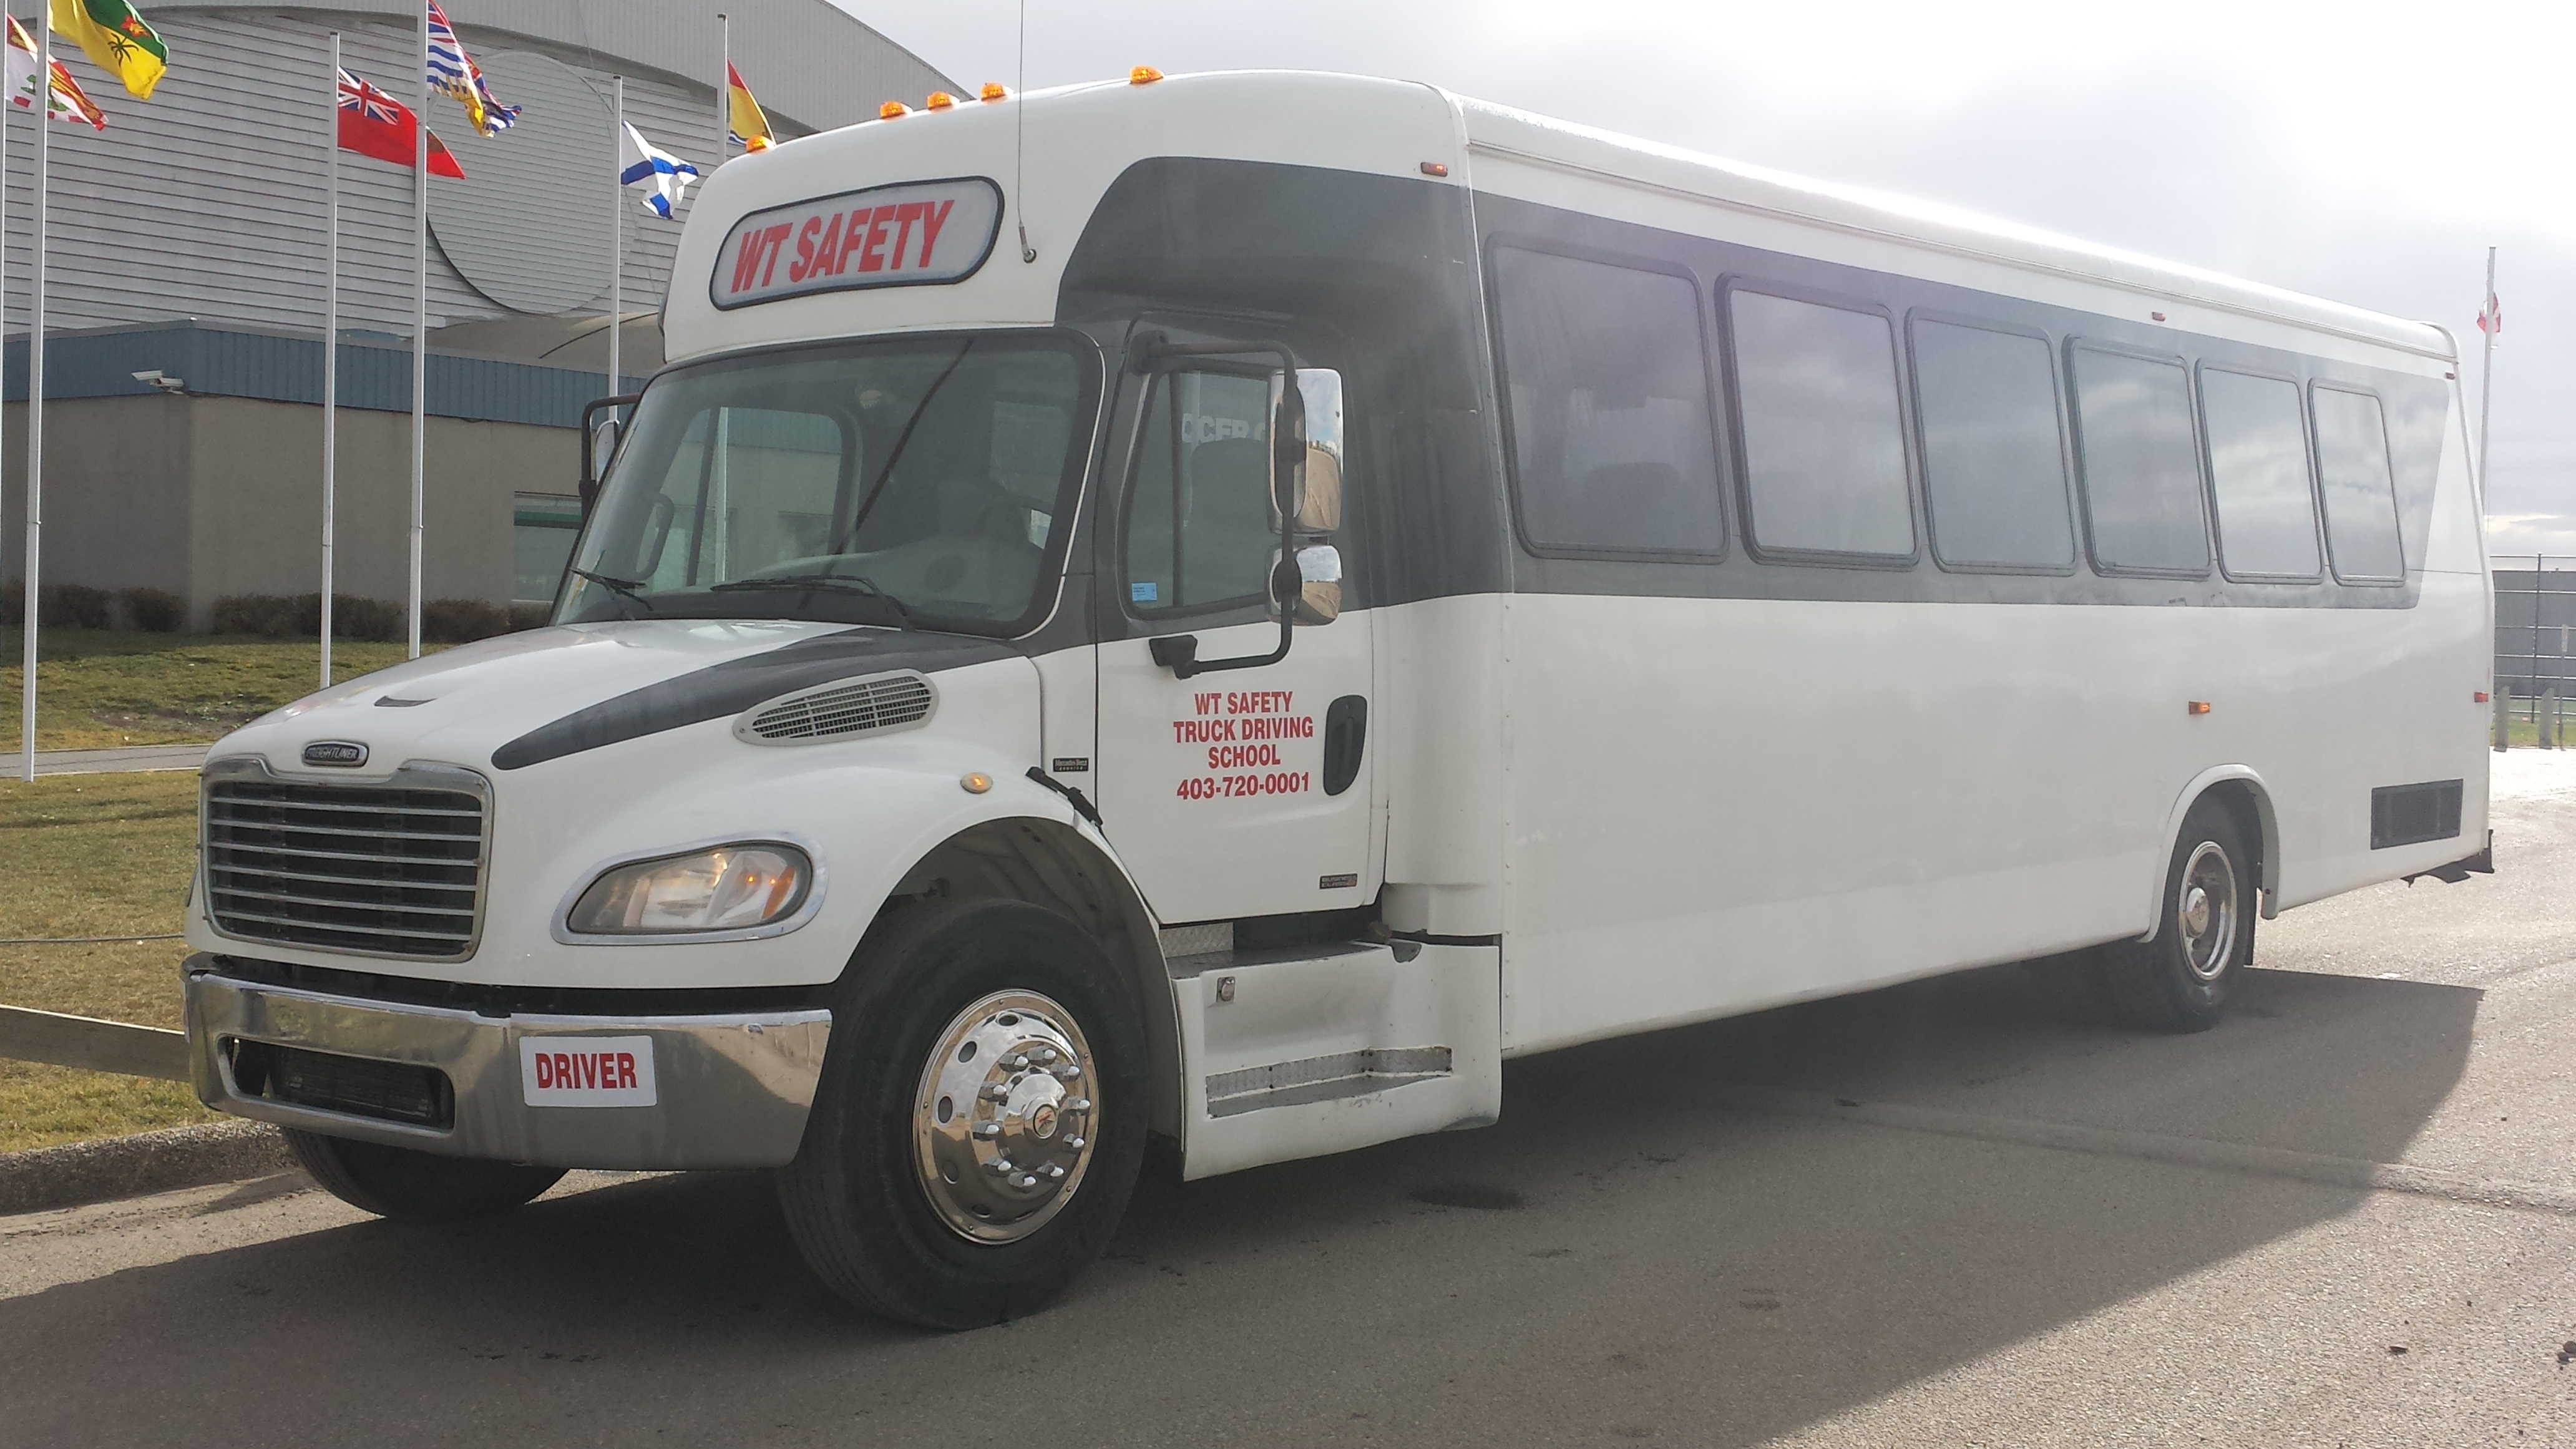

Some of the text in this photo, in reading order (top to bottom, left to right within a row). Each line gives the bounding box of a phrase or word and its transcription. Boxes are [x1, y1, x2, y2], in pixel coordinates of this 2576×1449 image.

[731, 199, 955, 293] WT SAFETY
[1194, 691, 1293, 715] WT SAFETY
[1173, 716, 1314, 743] TRUCK DRIVING
[1208, 744, 1281, 769] SCHOOL
[1176, 772, 1309, 800] 403-720-0001
[535, 1052, 638, 1089] DRIVER
